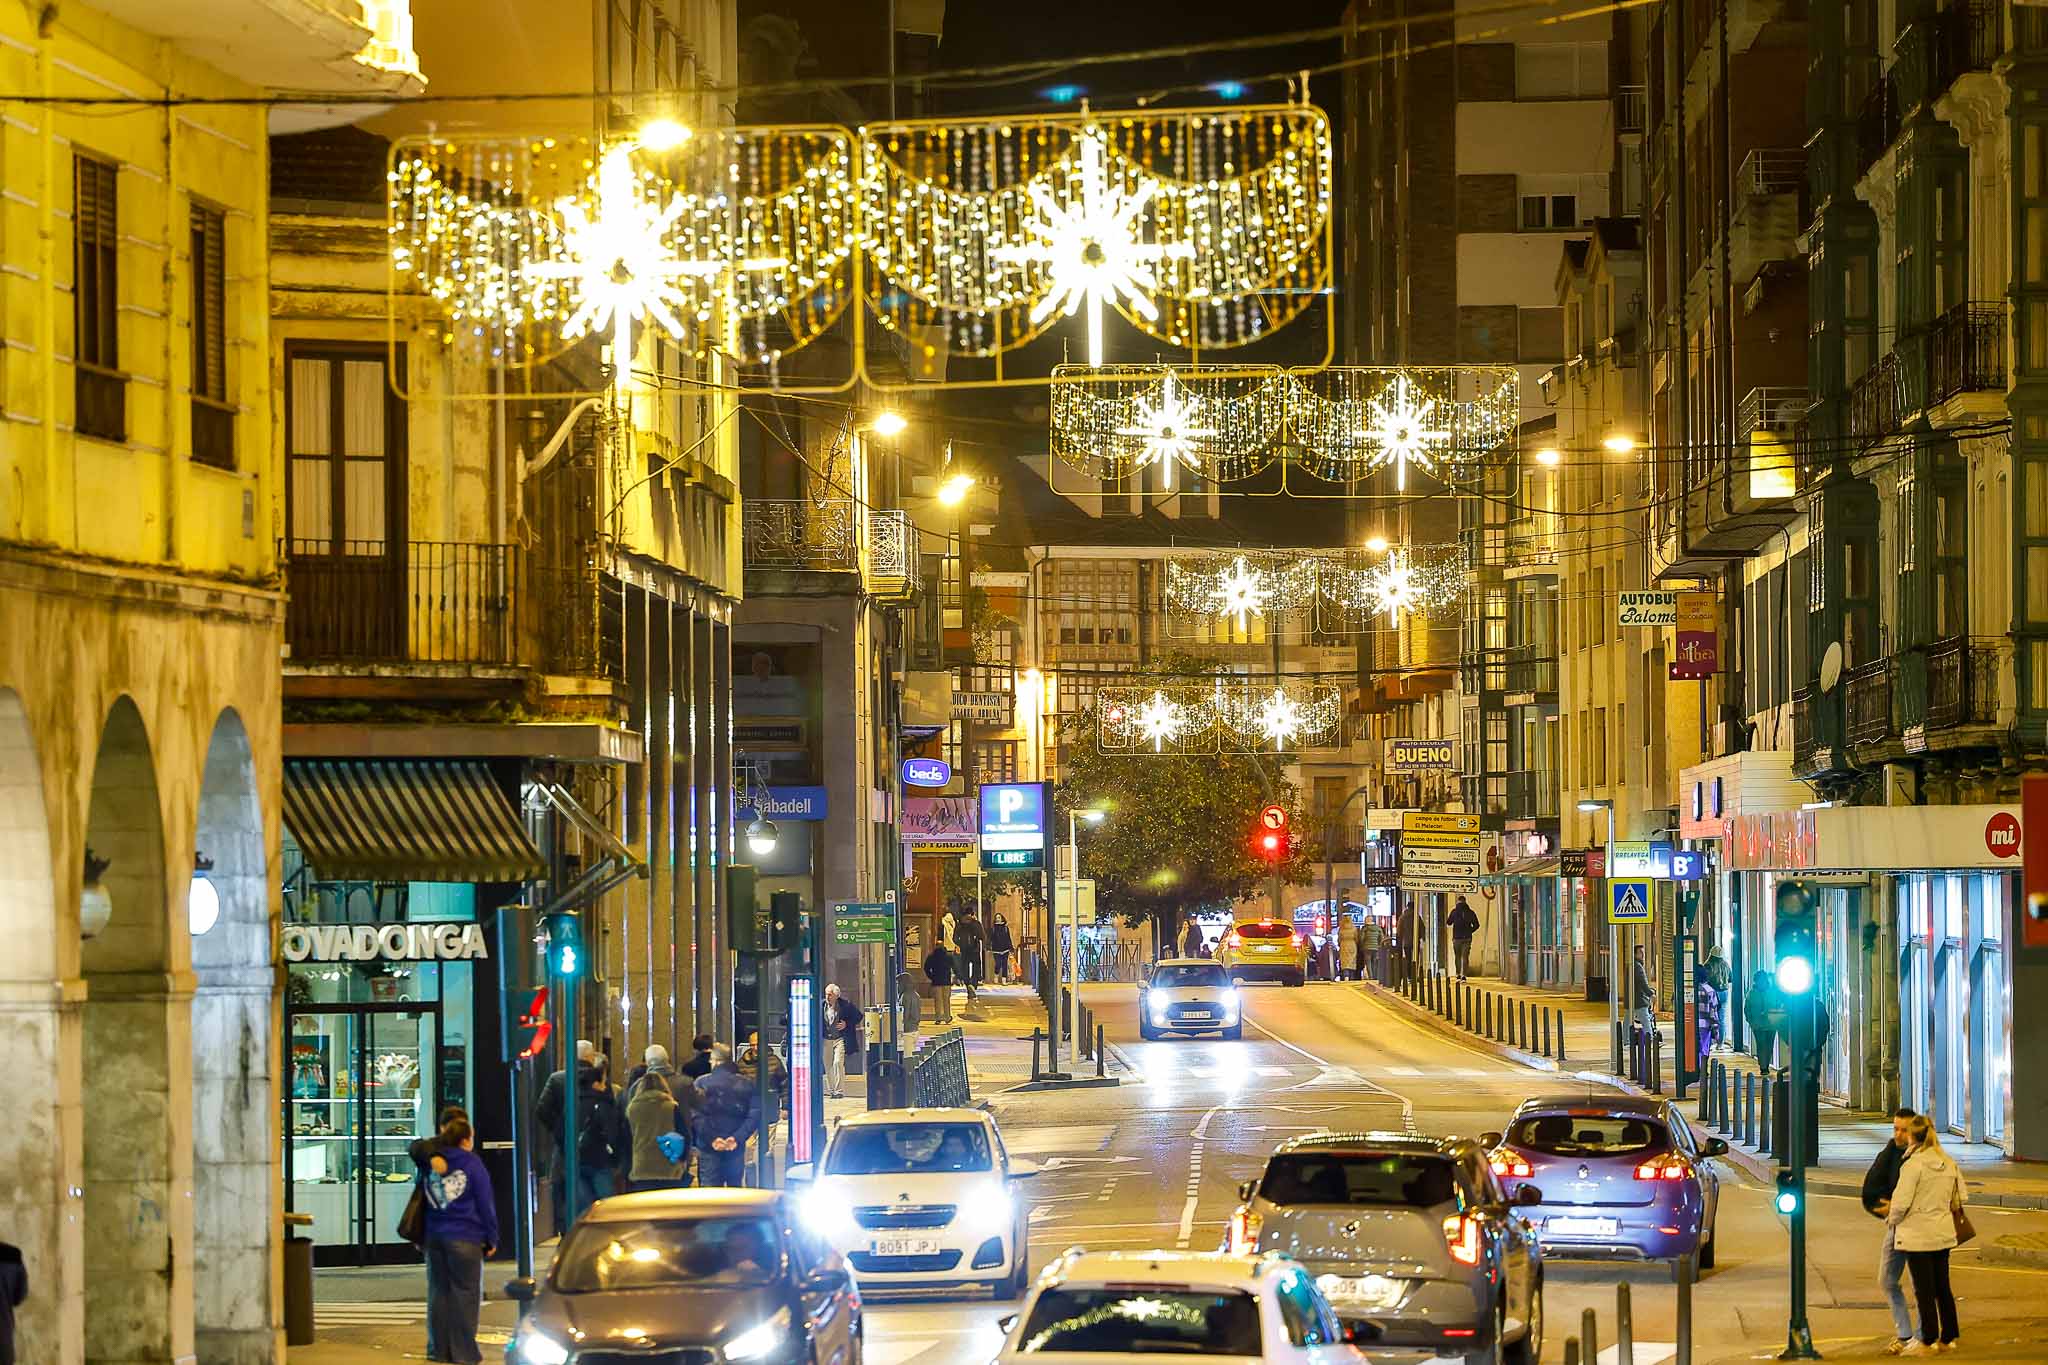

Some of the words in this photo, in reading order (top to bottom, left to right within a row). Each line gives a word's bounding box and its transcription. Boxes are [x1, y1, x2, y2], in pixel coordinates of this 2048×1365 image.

[1395, 747, 1452, 763] BUENO
[999, 789, 1024, 824] P
[1991, 824, 2016, 845] mi
[997, 852, 1027, 864] LIBRE
[1423, 881, 1460, 889] direcciones
[282, 923, 489, 961] OVADONGA
